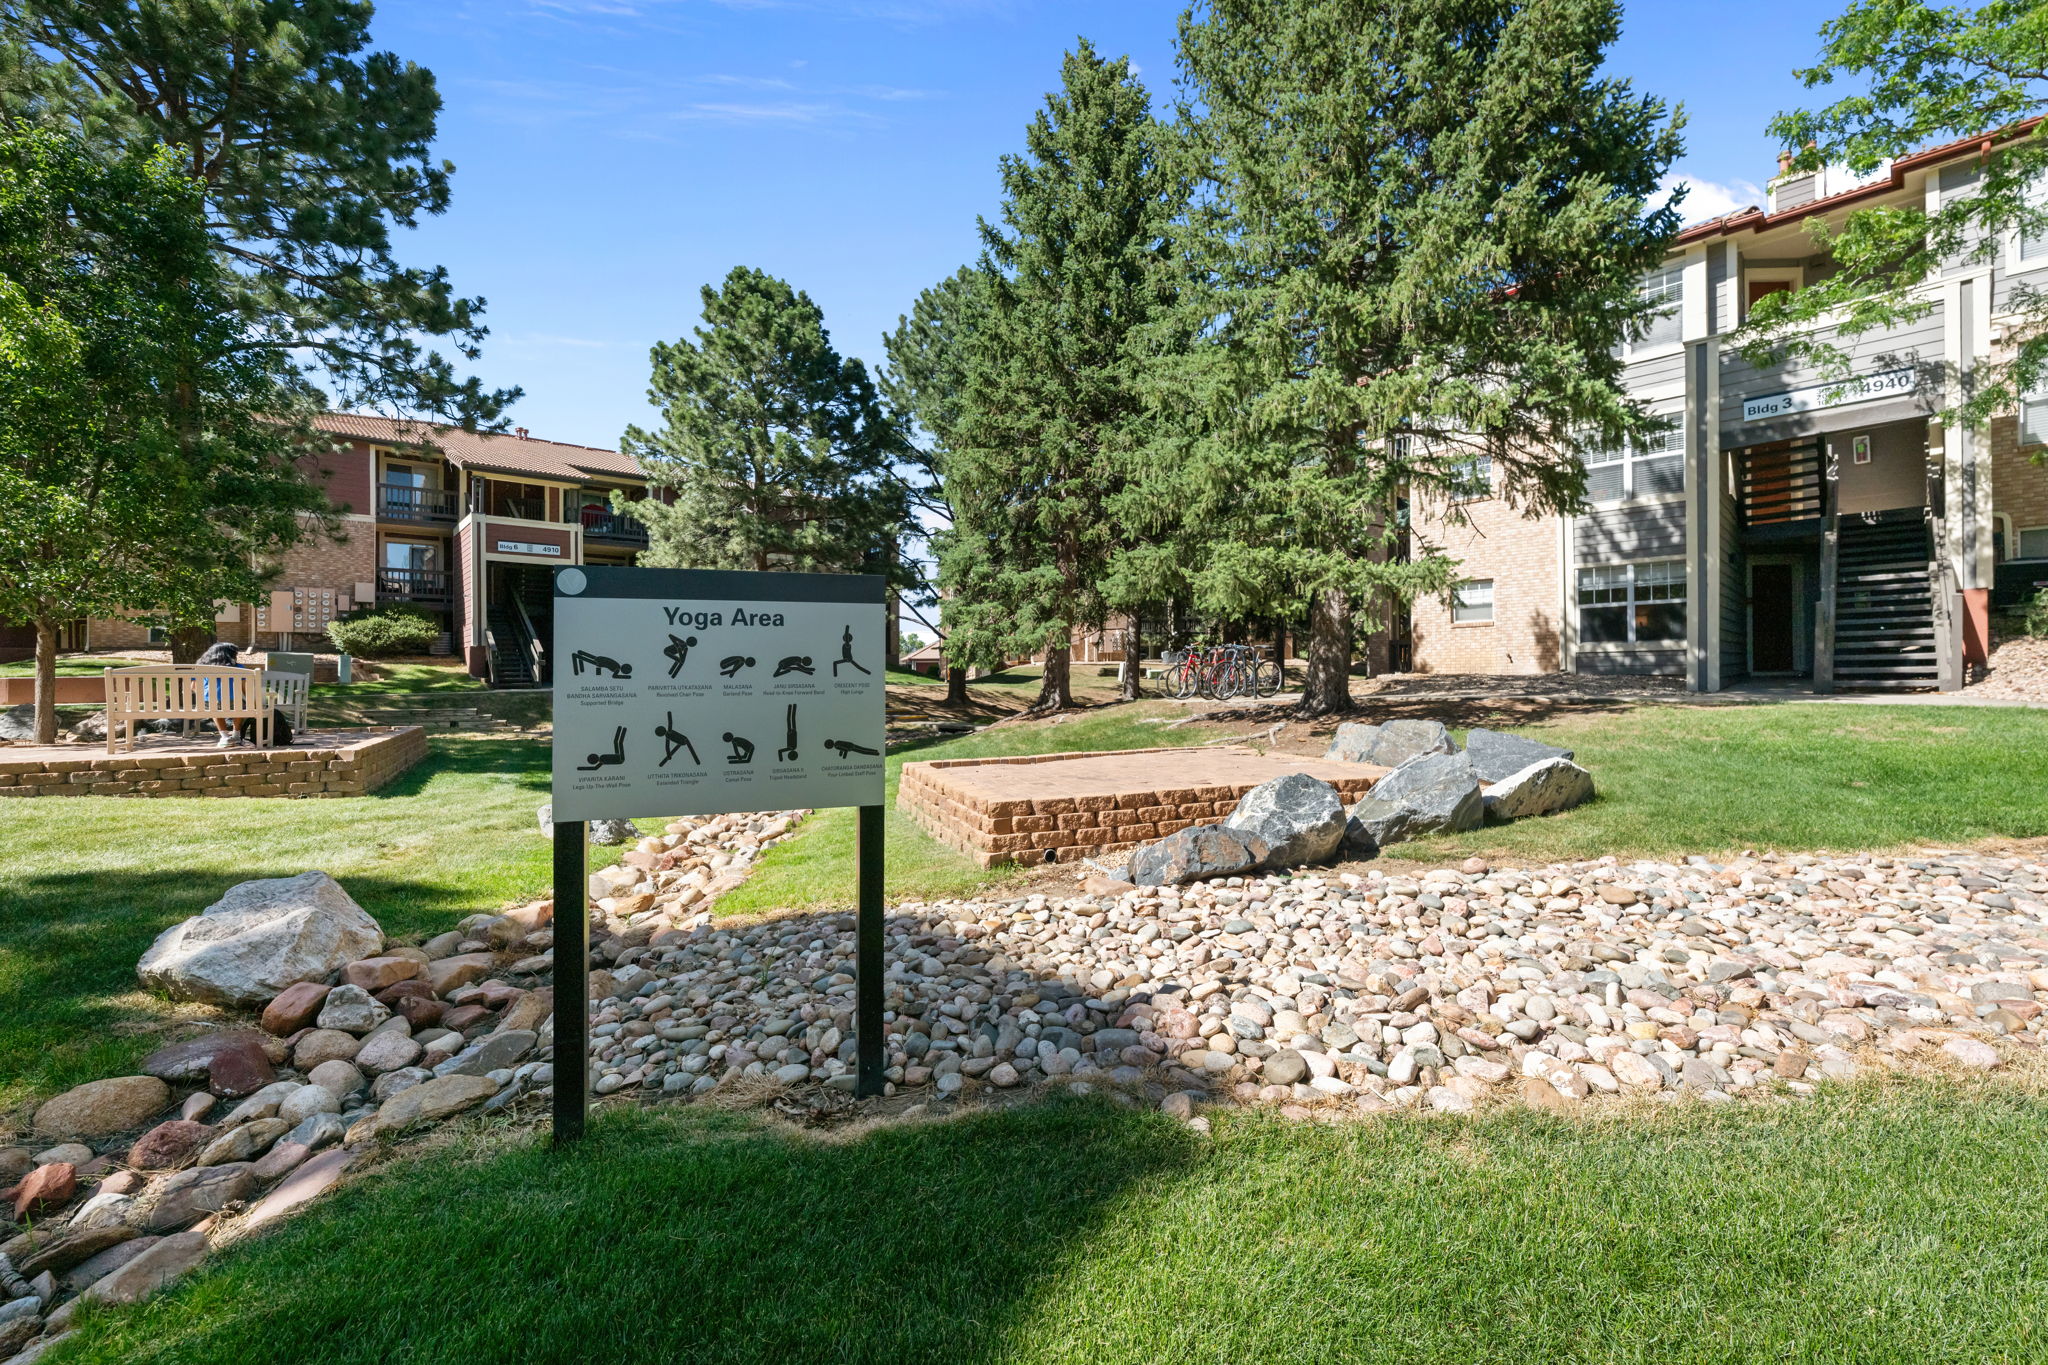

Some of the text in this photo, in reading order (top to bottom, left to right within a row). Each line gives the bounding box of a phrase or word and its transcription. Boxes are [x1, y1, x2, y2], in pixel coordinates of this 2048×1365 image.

[1862, 375, 1910, 394] 4940
[1747, 397, 1793, 416] Bldg 3
[663, 606, 785, 631] Yoga Area
